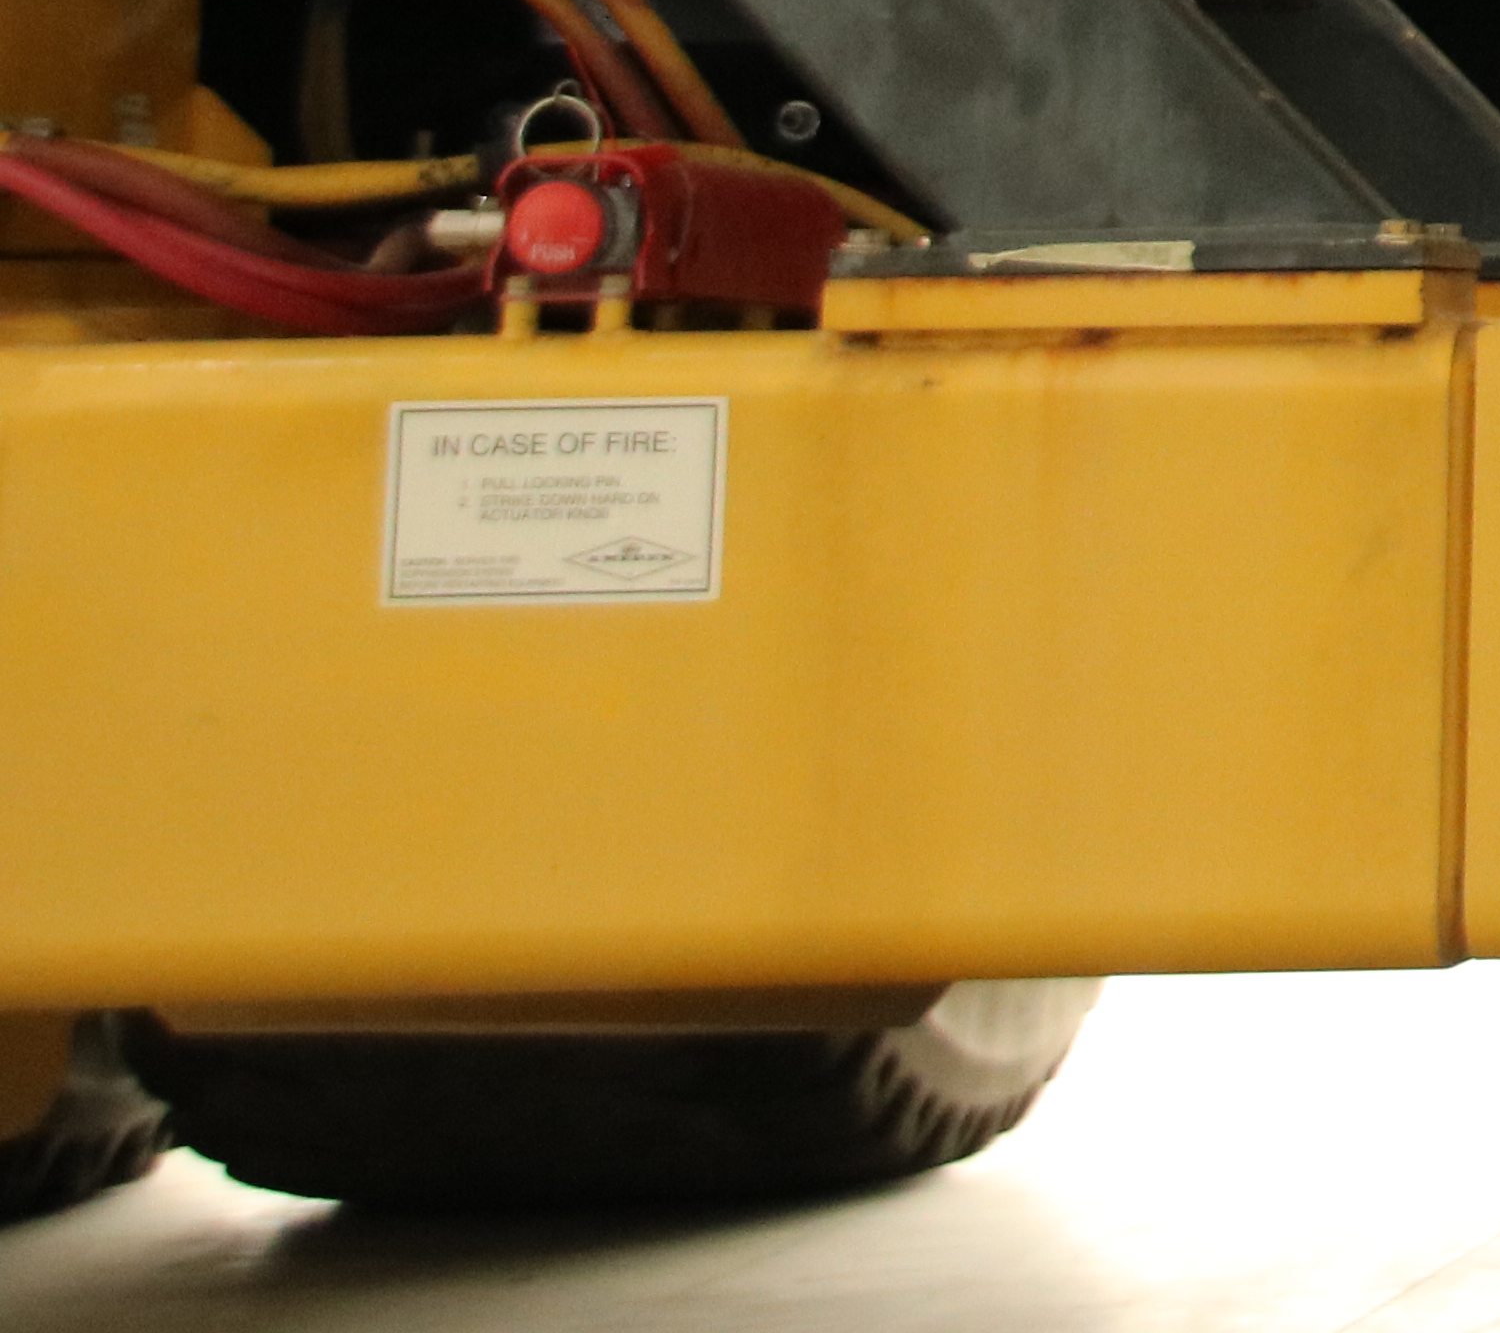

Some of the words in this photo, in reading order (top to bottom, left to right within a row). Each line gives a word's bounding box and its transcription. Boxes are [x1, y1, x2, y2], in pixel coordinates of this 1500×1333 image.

[432, 435, 460, 457] IN
[470, 433, 548, 456] CASE
[557, 432, 598, 455] OF
[605, 430, 677, 454] FIRE:
[481, 477, 516, 490] PULL
[523, 476, 591, 489] LOCKING
[480, 494, 534, 508] STRIKE
[539, 493, 588, 506] DOWN
[591, 492, 635, 505] HARD
[637, 491, 660, 504] ON
[479, 507, 564, 521] ACTUATOR
